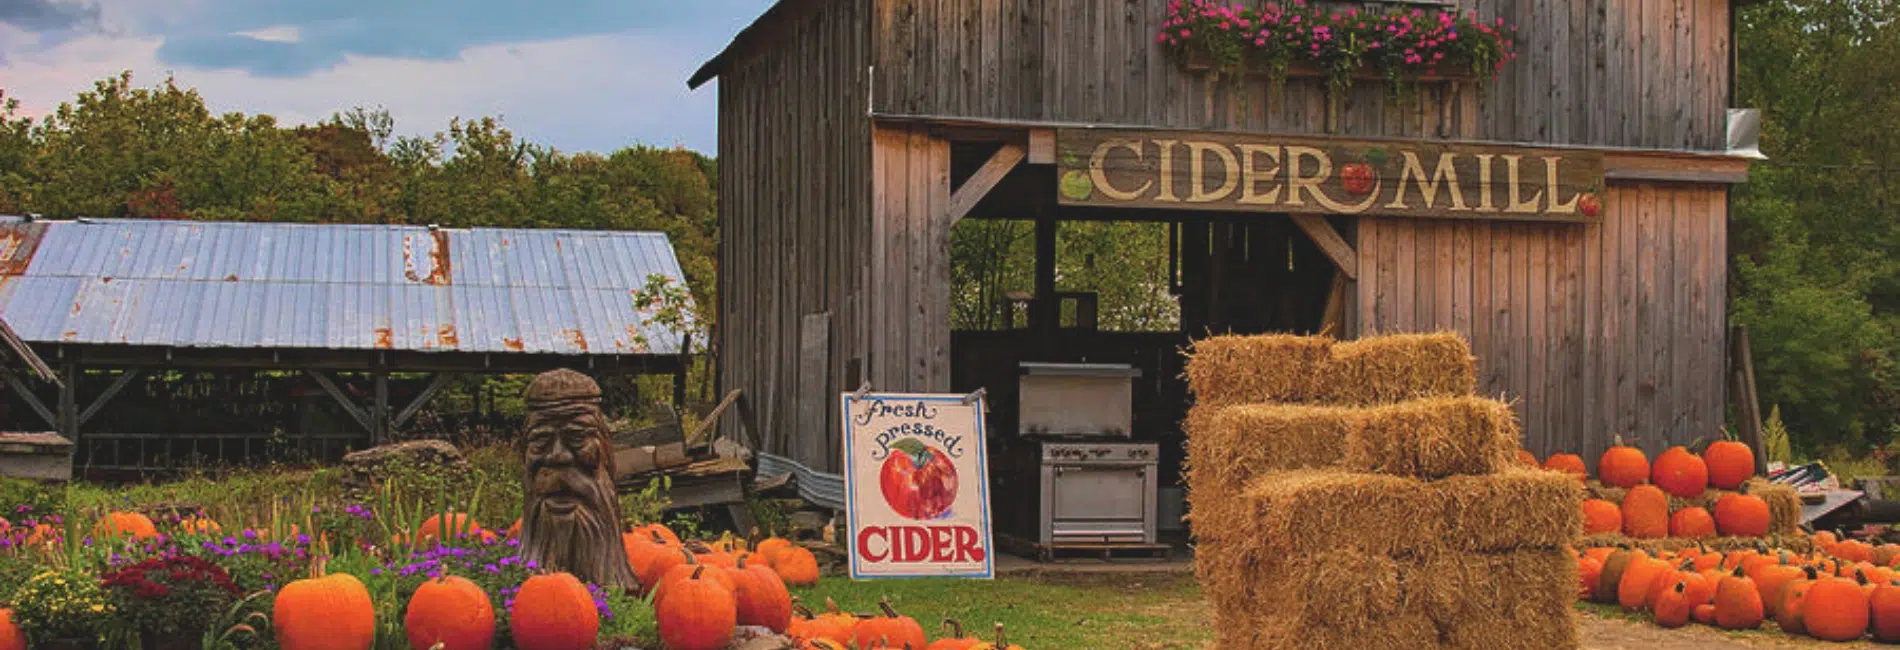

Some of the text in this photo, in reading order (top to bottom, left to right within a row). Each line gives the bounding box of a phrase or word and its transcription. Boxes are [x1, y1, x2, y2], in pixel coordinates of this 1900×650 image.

[1089, 137, 1582, 214] CIDER MILL
[855, 400, 937, 425] fresh
[872, 422, 963, 461] pressed
[857, 525, 986, 563] CIDER
